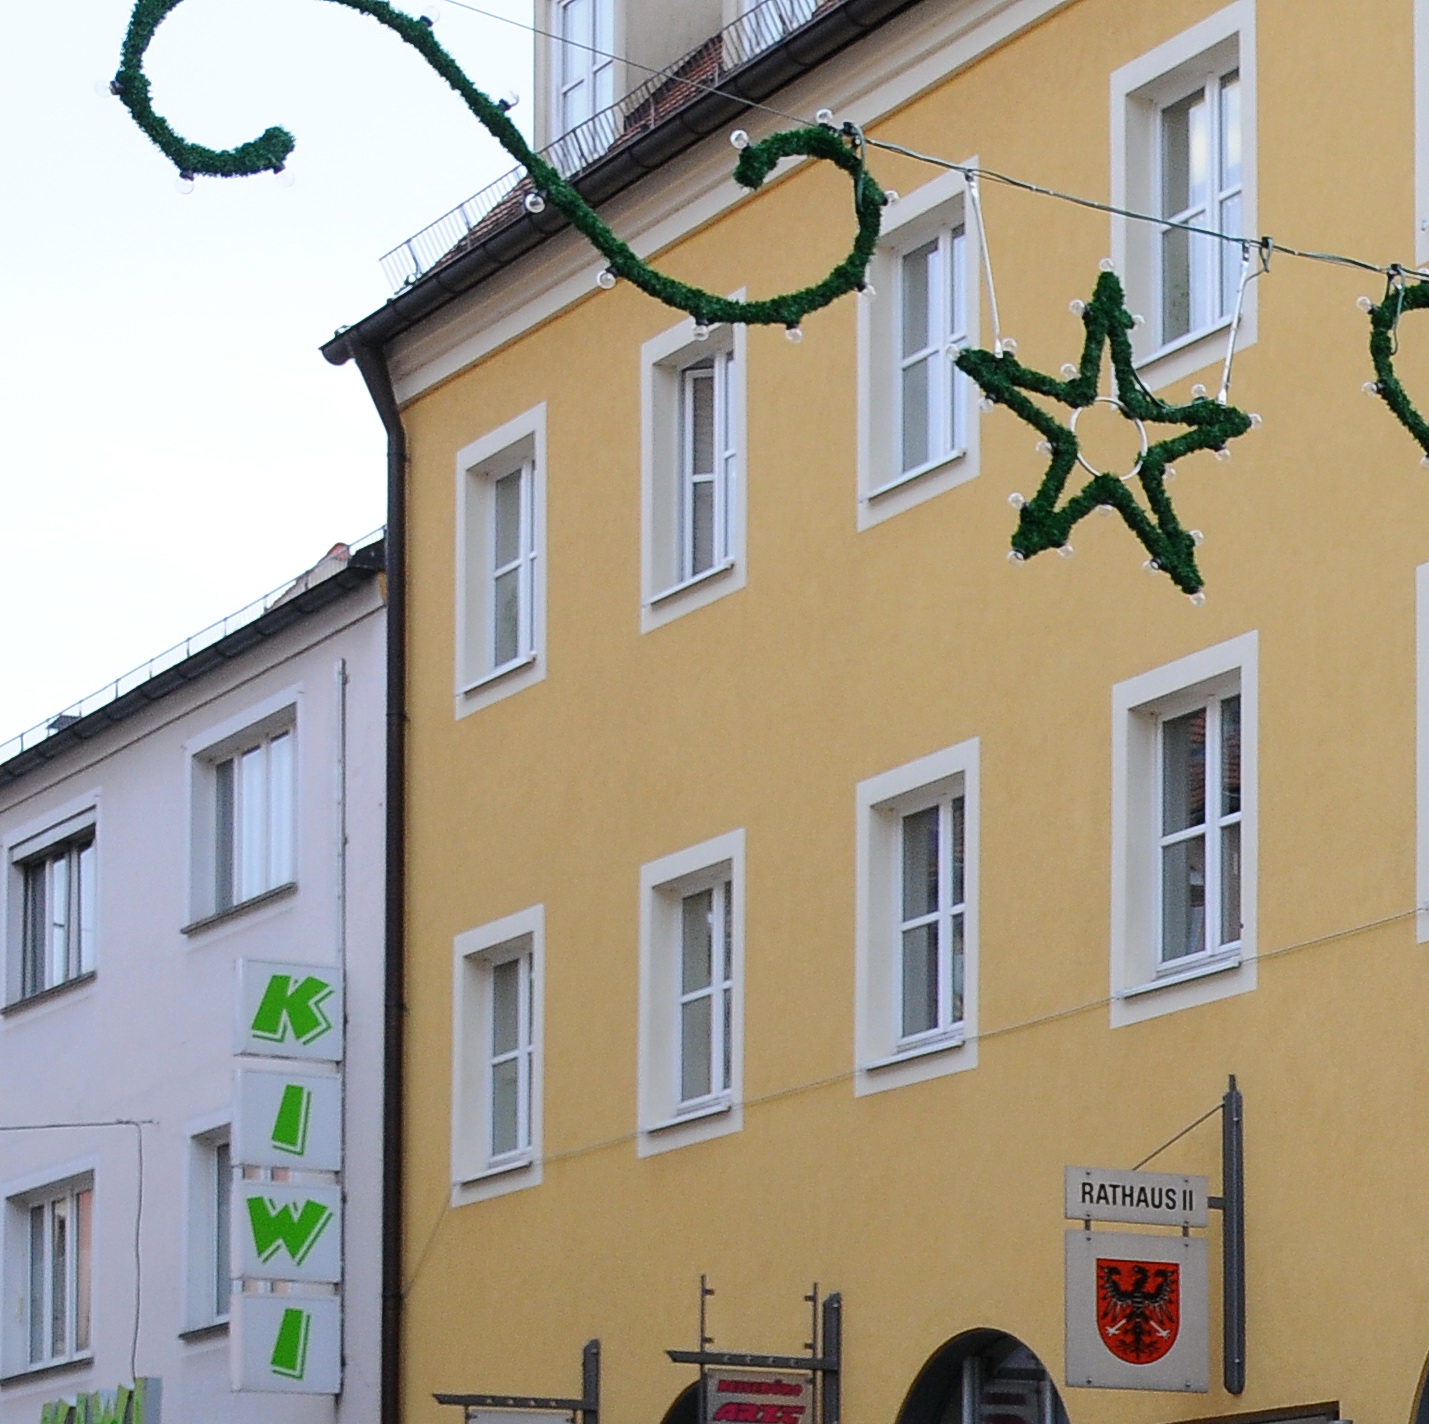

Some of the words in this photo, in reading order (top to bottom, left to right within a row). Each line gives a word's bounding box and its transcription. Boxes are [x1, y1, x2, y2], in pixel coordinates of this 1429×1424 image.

[251, 974, 335, 1381] KIWI
[1081, 1181, 1177, 1211] RATHAUS
[1182, 1189, 1194, 1212] II
